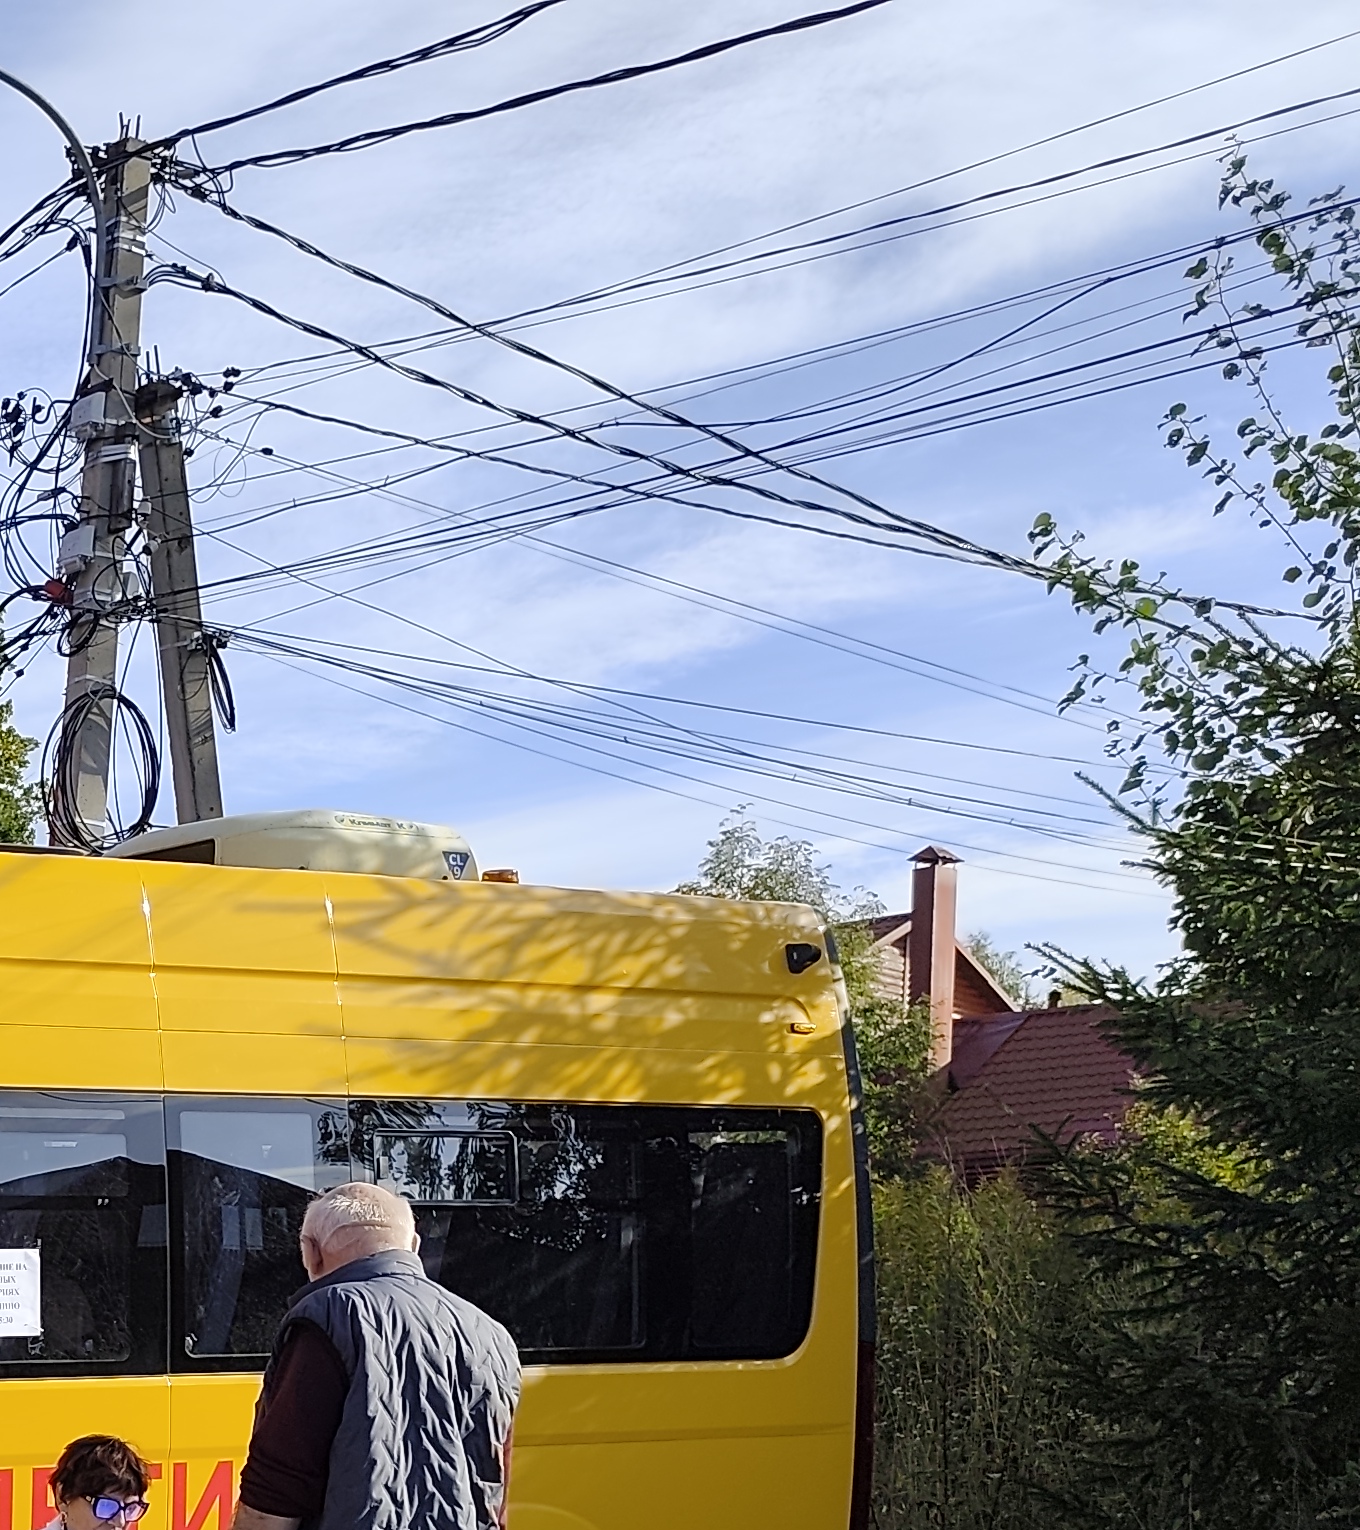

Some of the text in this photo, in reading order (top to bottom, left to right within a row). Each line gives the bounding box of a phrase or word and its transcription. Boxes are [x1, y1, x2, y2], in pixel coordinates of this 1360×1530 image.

[448, 853, 464, 866] CL
[453, 866, 461, 879] 9
[15, 1263, 28, 1271] НА
